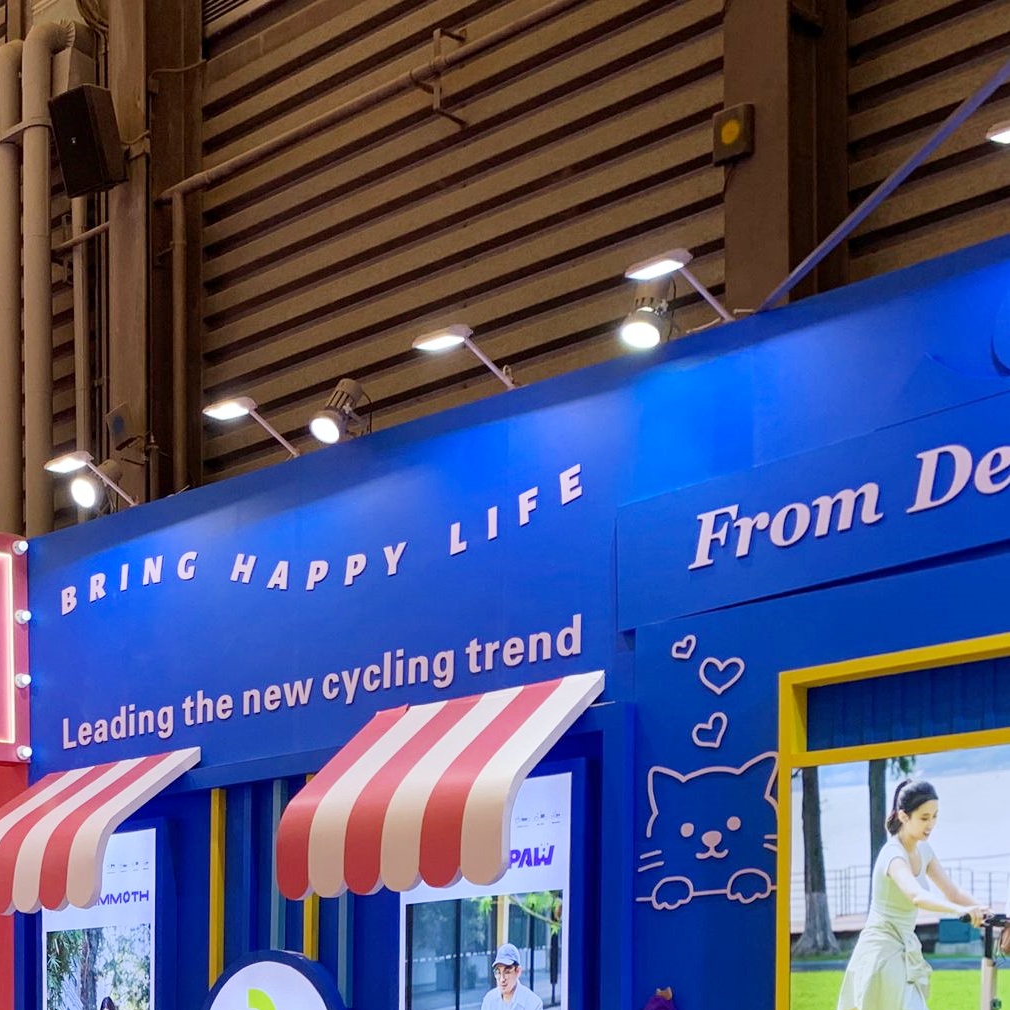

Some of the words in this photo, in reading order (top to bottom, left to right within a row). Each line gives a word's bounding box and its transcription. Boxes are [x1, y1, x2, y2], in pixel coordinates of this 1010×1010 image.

[61, 551, 199, 616] BRING
[230, 542, 408, 592] HAPPY
[450, 463, 584, 556] LIFE
[688, 482, 884, 570] From
[62, 703, 174, 750] Leading
[182, 690, 234, 726] the
[243, 677, 314, 716] new
[322, 648, 455, 705] cycling
[465, 613, 582, 673] trend
[96, 890, 150, 906] MMOTH
